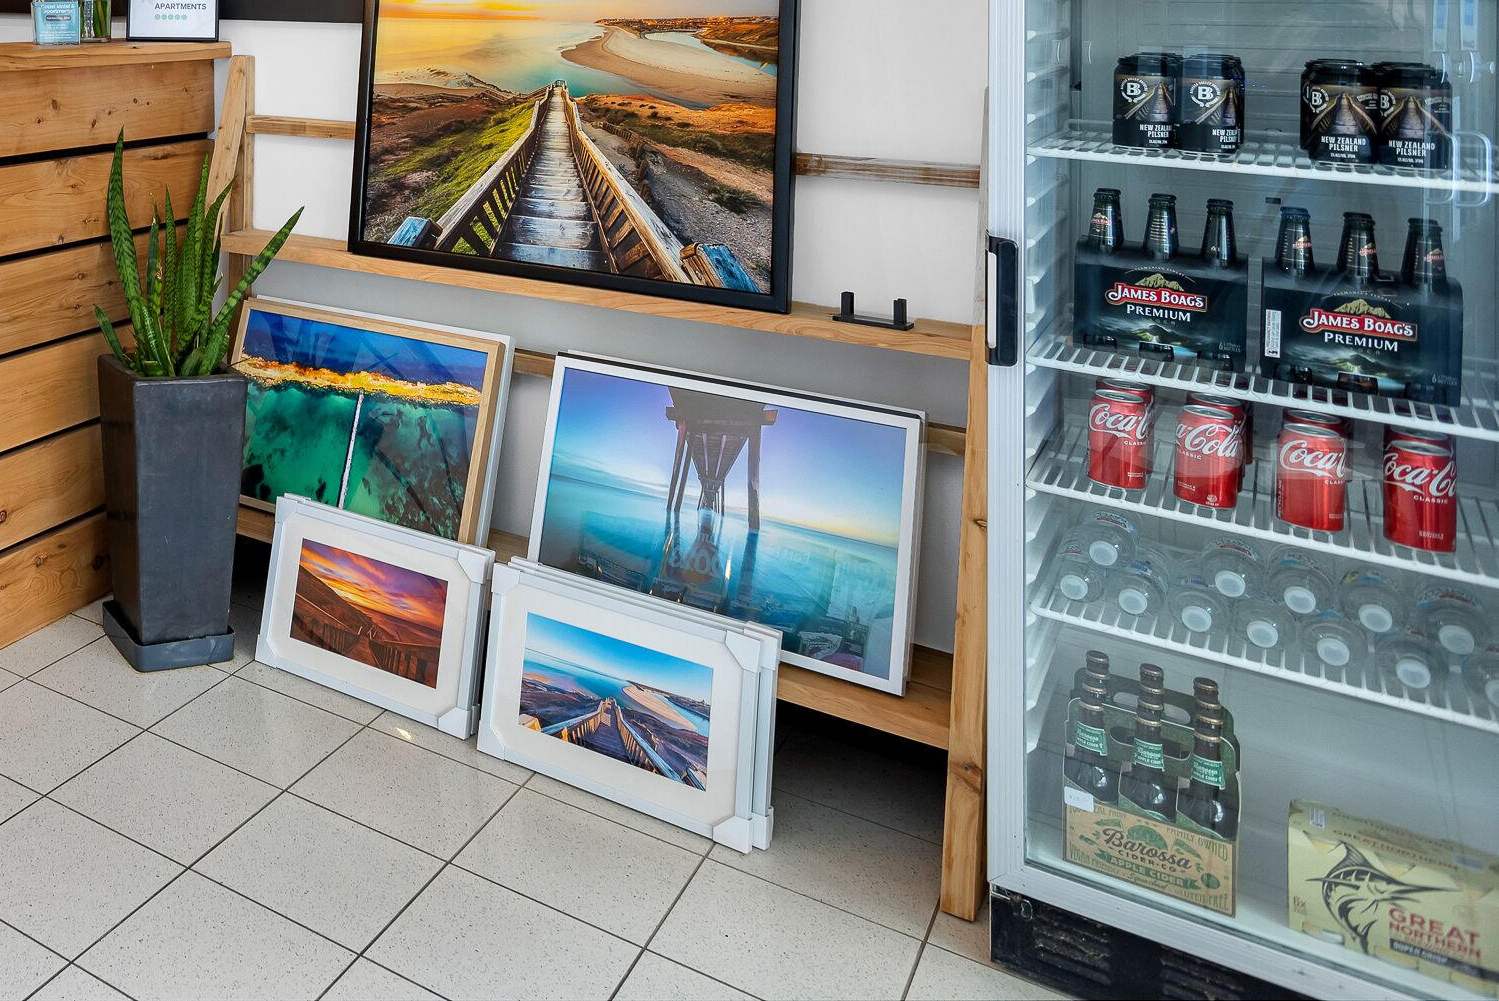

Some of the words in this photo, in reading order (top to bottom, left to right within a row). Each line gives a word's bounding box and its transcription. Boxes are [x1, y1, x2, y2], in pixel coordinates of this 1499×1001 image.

[1321, 136, 1336, 144] NEW
[1337, 137, 1366, 145] ZEALAND
[1329, 144, 1358, 152] PILSNER
[1388, 140, 1403, 148] NEW
[1404, 141, 1435, 150] ZEALAND
[1396, 148, 1426, 157] PILSNER
[1108, 285, 1158, 301] JAMES
[1160, 290, 1204, 307] BOAG'S
[1126, 304, 1191, 322] PREMIUM
[1303, 311, 1360, 329] JAMES
[1364, 317, 1414, 337] BOAG'S
[1324, 332, 1398, 352] PREMIUM
[1413, 495, 1448, 504] CLASSIC
[1103, 828, 1192, 870] Barossa
[1167, 827, 1195, 842] FAMILY
[1197, 835, 1228, 861] OWNED
[1069, 843, 1091, 863] VEGAN
[1208, 893, 1229, 911] FREE
[1110, 858, 1146, 875] APPLE
[1149, 870, 1184, 888] CIDER
[1388, 907, 1481, 946] GREAT
[1389, 922, 1481, 959] NORTHERN
[1393, 941, 1420, 955] SUPER
[1421, 949, 1448, 963] CRISP
